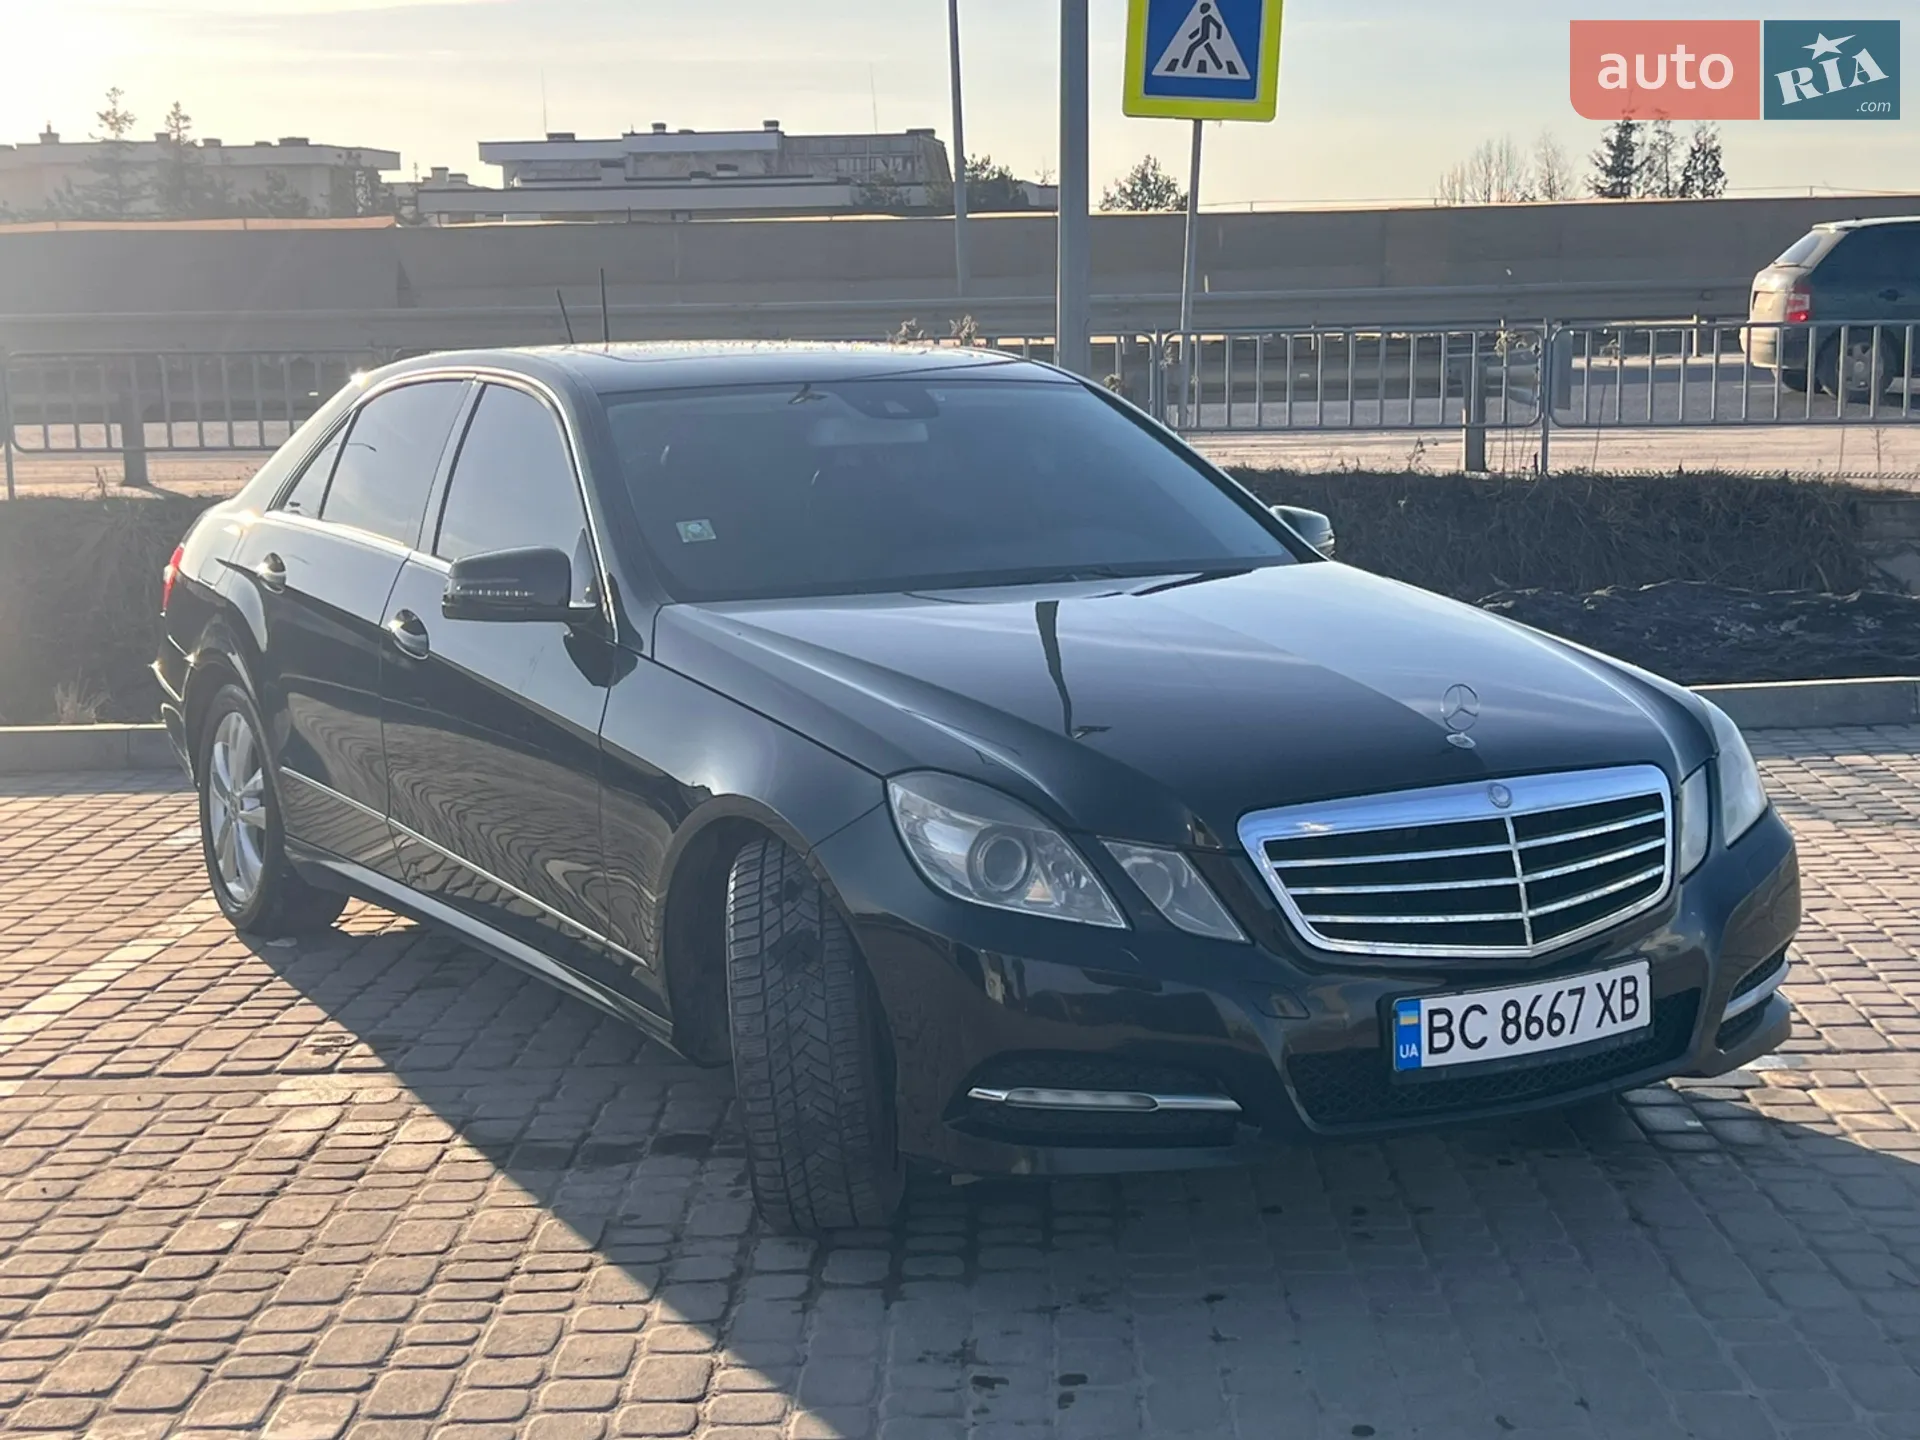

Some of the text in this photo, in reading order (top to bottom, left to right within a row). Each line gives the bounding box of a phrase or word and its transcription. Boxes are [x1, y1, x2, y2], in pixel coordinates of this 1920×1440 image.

[1428, 975, 1639, 1055] BC 8667 XB
[1399, 1044, 1418, 1058] UA
